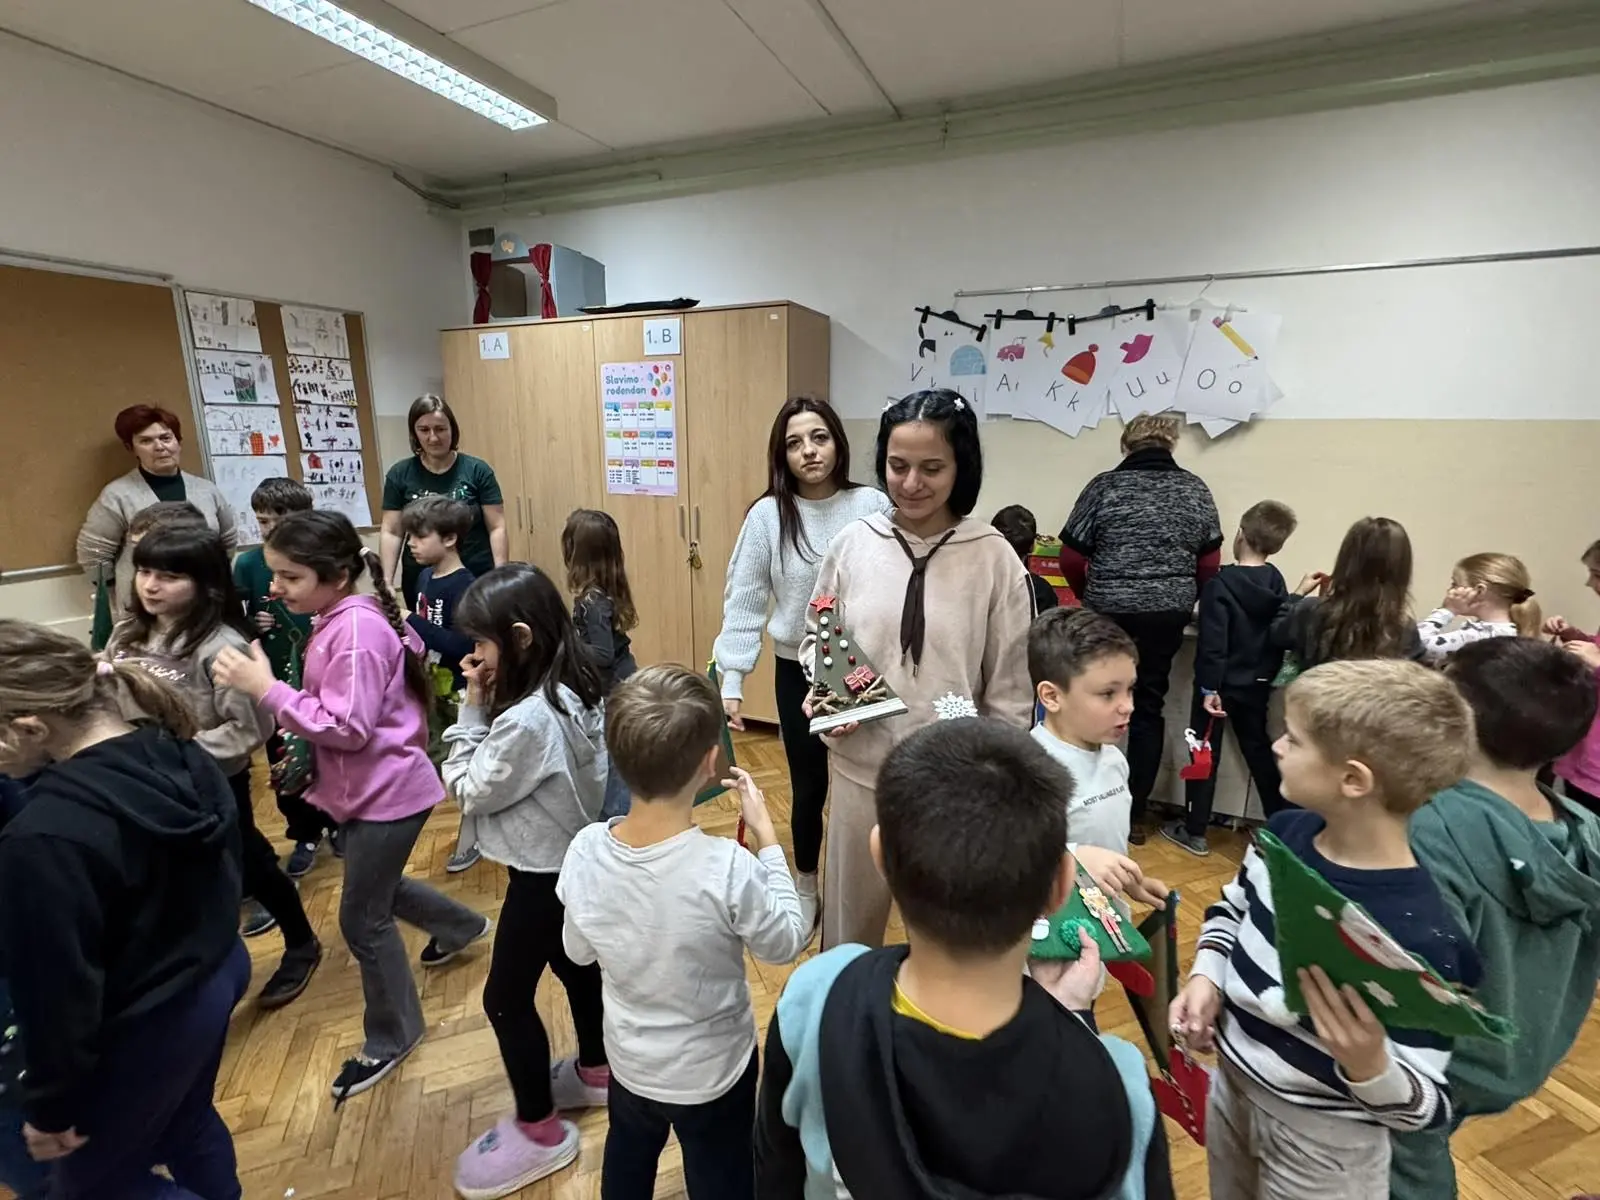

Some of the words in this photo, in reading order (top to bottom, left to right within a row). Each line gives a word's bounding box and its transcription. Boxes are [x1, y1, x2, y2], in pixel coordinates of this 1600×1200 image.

[481, 338, 491, 352] 1.
[494, 337, 503, 351] A
[646, 329, 658, 344] 1.
[662, 328, 672, 343] B
[605, 374, 640, 385] Slavimo
[911, 362, 923, 381] V
[1197, 368, 1216, 390] O
[1228, 380, 1242, 394] o
[996, 373, 1011, 392] A
[1126, 377, 1147, 398] U
[1156, 371, 1170, 385] u
[1045, 380, 1064, 401] K
[1067, 391, 1079, 412] k
